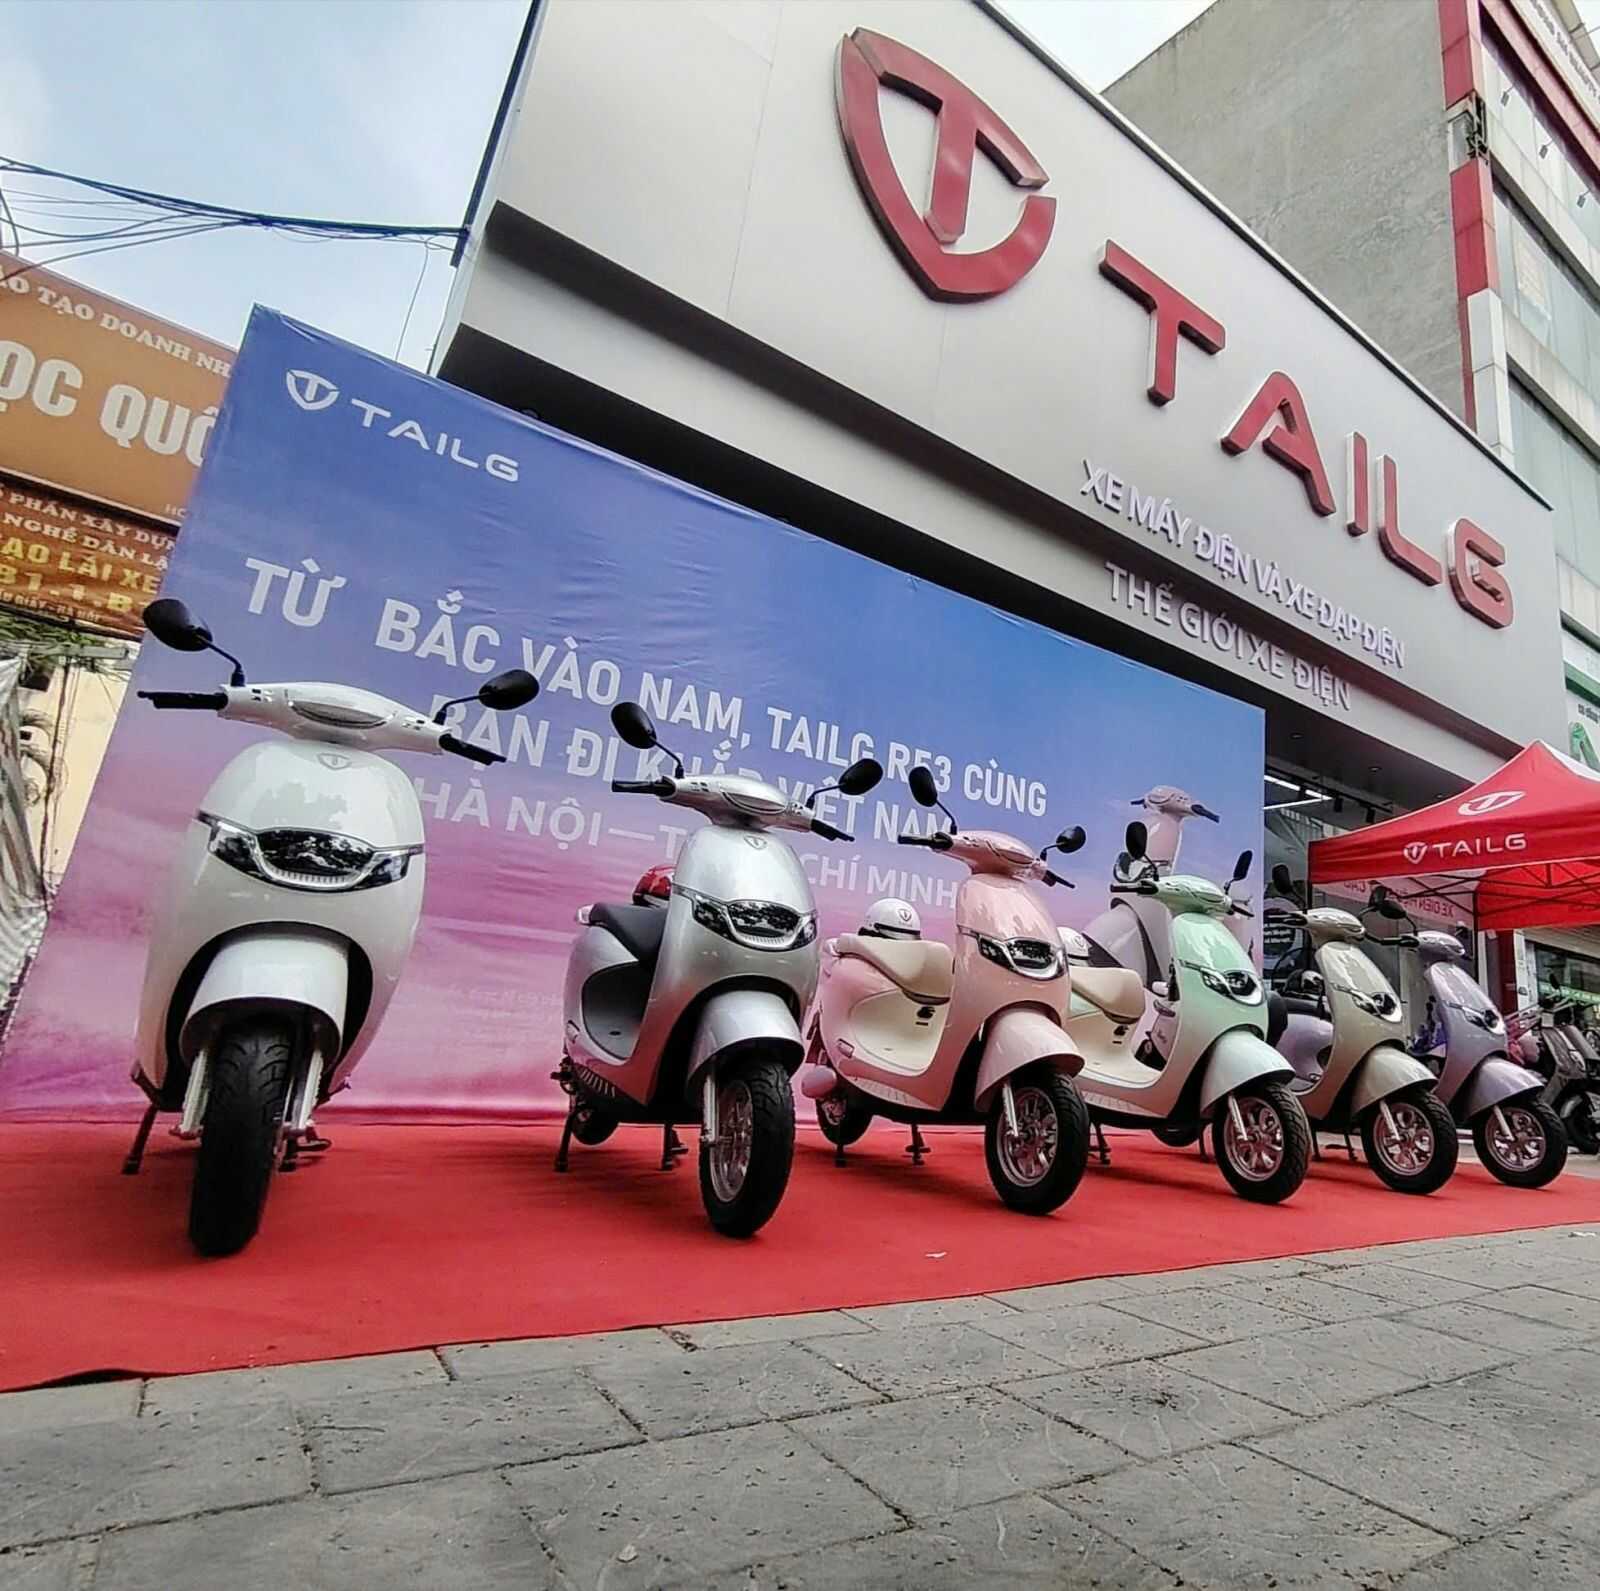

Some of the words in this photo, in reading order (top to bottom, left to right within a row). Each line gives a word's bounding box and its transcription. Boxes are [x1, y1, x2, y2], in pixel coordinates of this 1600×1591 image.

[37, 286, 95, 321] TẠO
[99, 311, 192, 361] DOANH
[351, 398, 520, 483] TAILG
[1099, 239, 1516, 631] TAILG
[119, 567, 162, 595] XE
[1079, 458, 1125, 514] XE
[1127, 485, 1192, 549] MÁY
[1193, 524, 1250, 585] ĐIỆN
[1253, 557, 1283, 604] VÀ
[1285, 577, 1317, 620] XE
[1317, 596, 1362, 642] ĐẠP
[1360, 621, 1405, 670] ĐIỆN
[244, 556, 347, 628] TỪ
[374, 589, 501, 675] BẮC
[521, 635, 622, 707] VÀO
[767, 706, 875, 768] TAILG
[963, 758, 1048, 818] CÙNG
[1104, 560, 1176, 627] THẾ
[1178, 601, 1246, 660] GIỚI
[1247, 632, 1287, 679] XE
[1290, 656, 1351, 712] ĐIỆN
[429, 694, 550, 771] BẠN
[565, 727, 621, 782] ĐI
[413, 776, 491, 829] HÀ
[800, 853, 863, 892] CHÍ
[866, 864, 958, 911] MINH
[1431, 832, 1527, 859] TAILG
